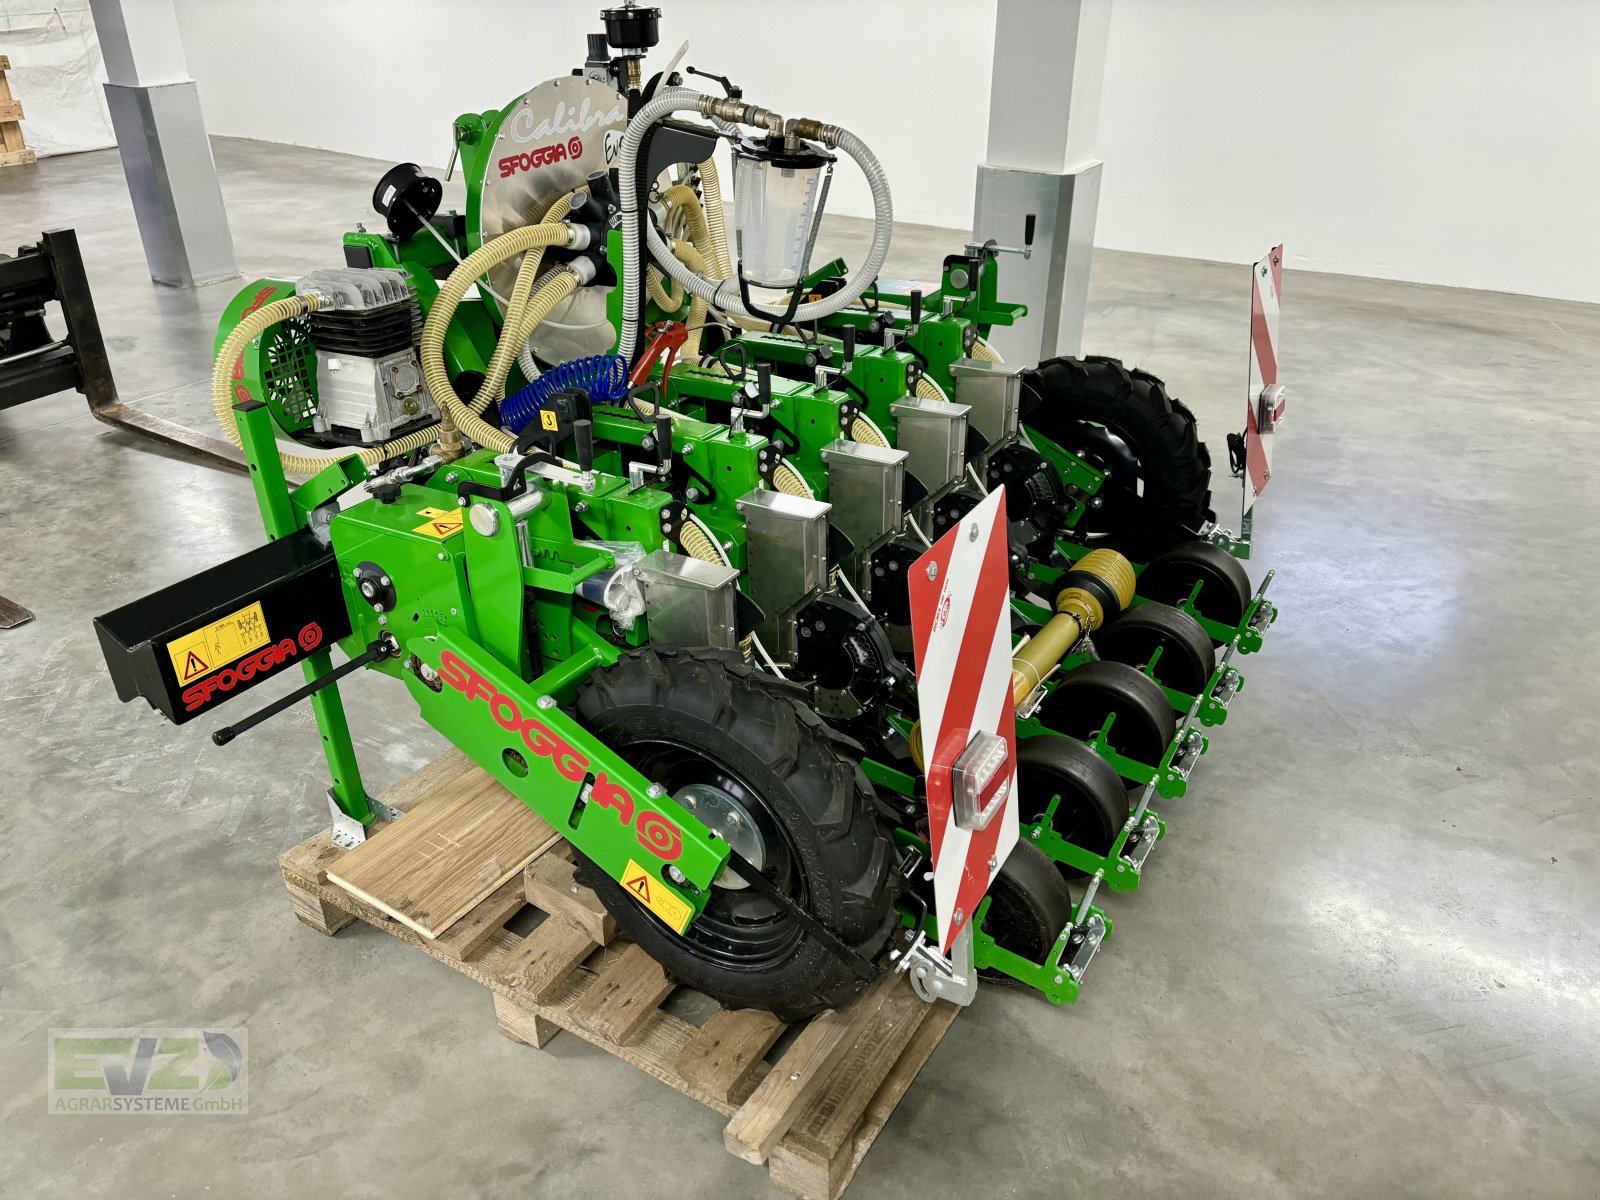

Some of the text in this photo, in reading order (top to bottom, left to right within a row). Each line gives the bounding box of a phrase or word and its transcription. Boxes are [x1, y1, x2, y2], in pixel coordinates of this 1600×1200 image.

[511, 98, 624, 143] Calibra
[498, 143, 567, 179] SFOGGIA
[182, 638, 297, 712] SFOGGIA
[438, 650, 635, 826] SFOGGIA
